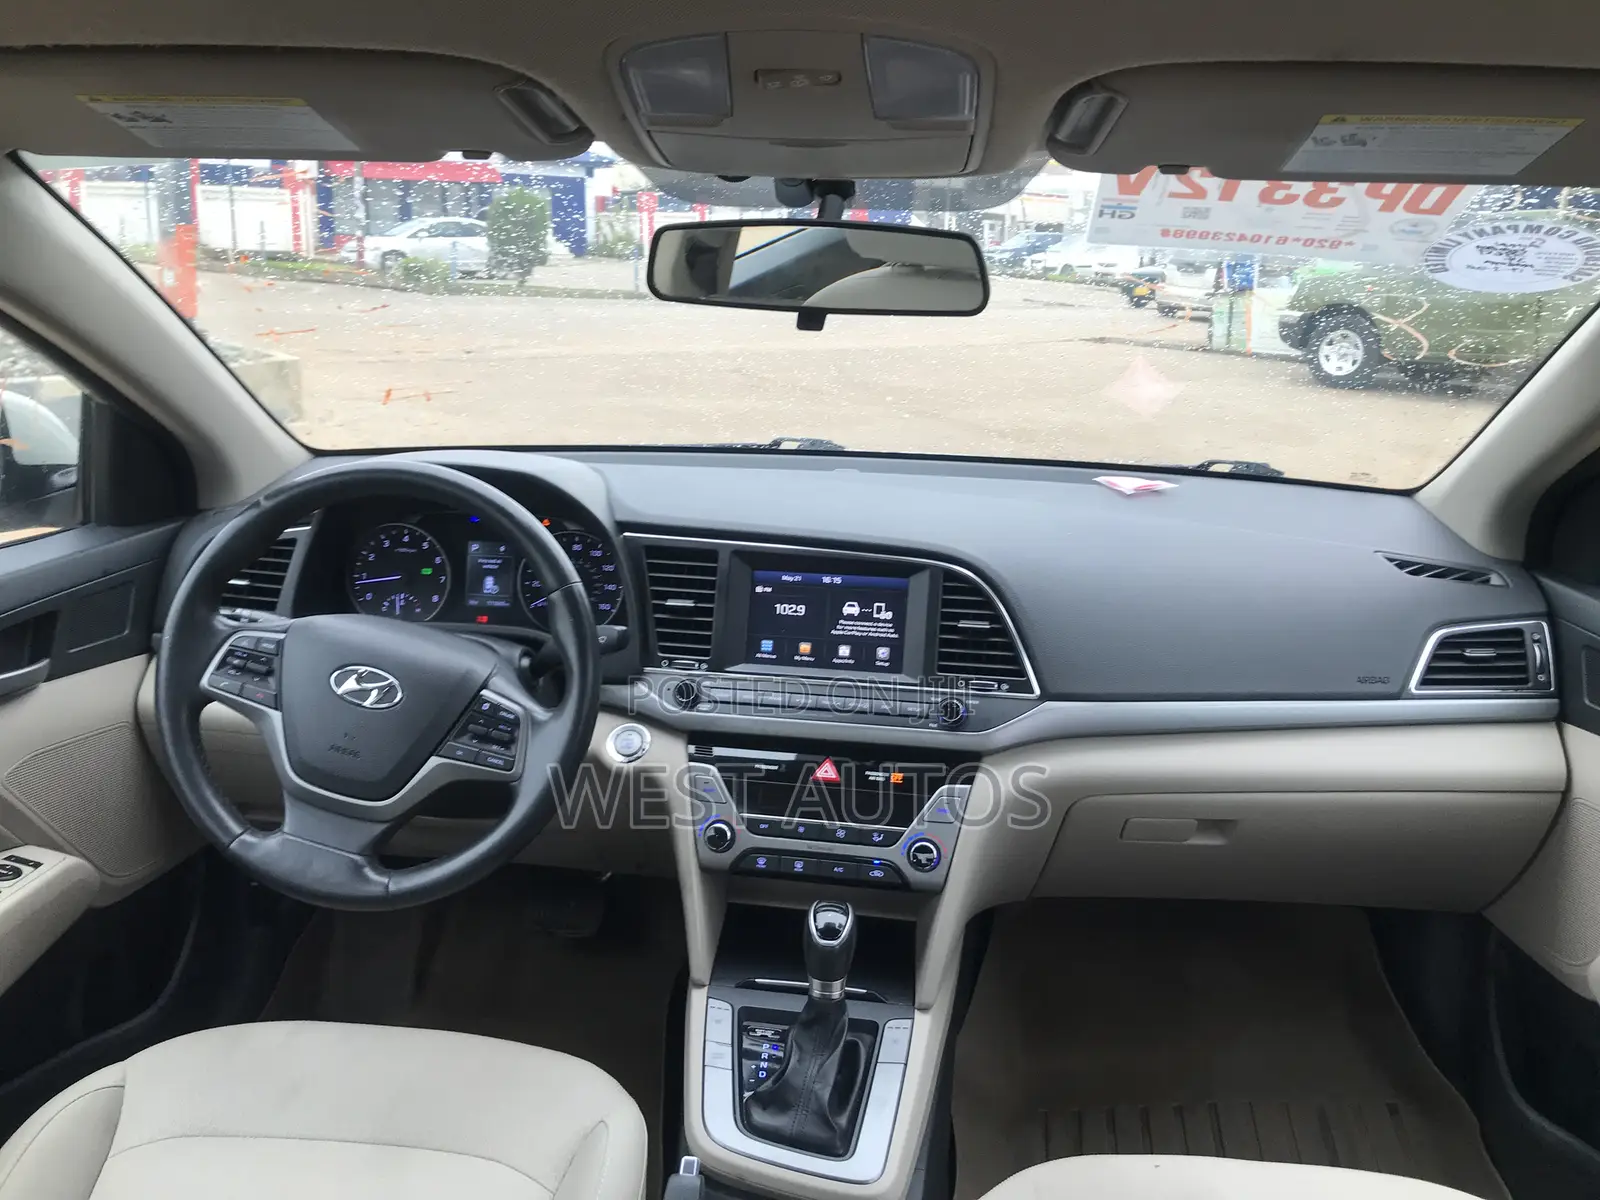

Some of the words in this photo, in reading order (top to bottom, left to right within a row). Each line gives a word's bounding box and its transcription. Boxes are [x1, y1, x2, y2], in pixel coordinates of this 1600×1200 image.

[383, 540, 390, 548] 3
[368, 553, 375, 561] 2
[761, 1052, 769, 1060] R
[760, 1061, 768, 1069] N
[758, 1070, 767, 1078] D
